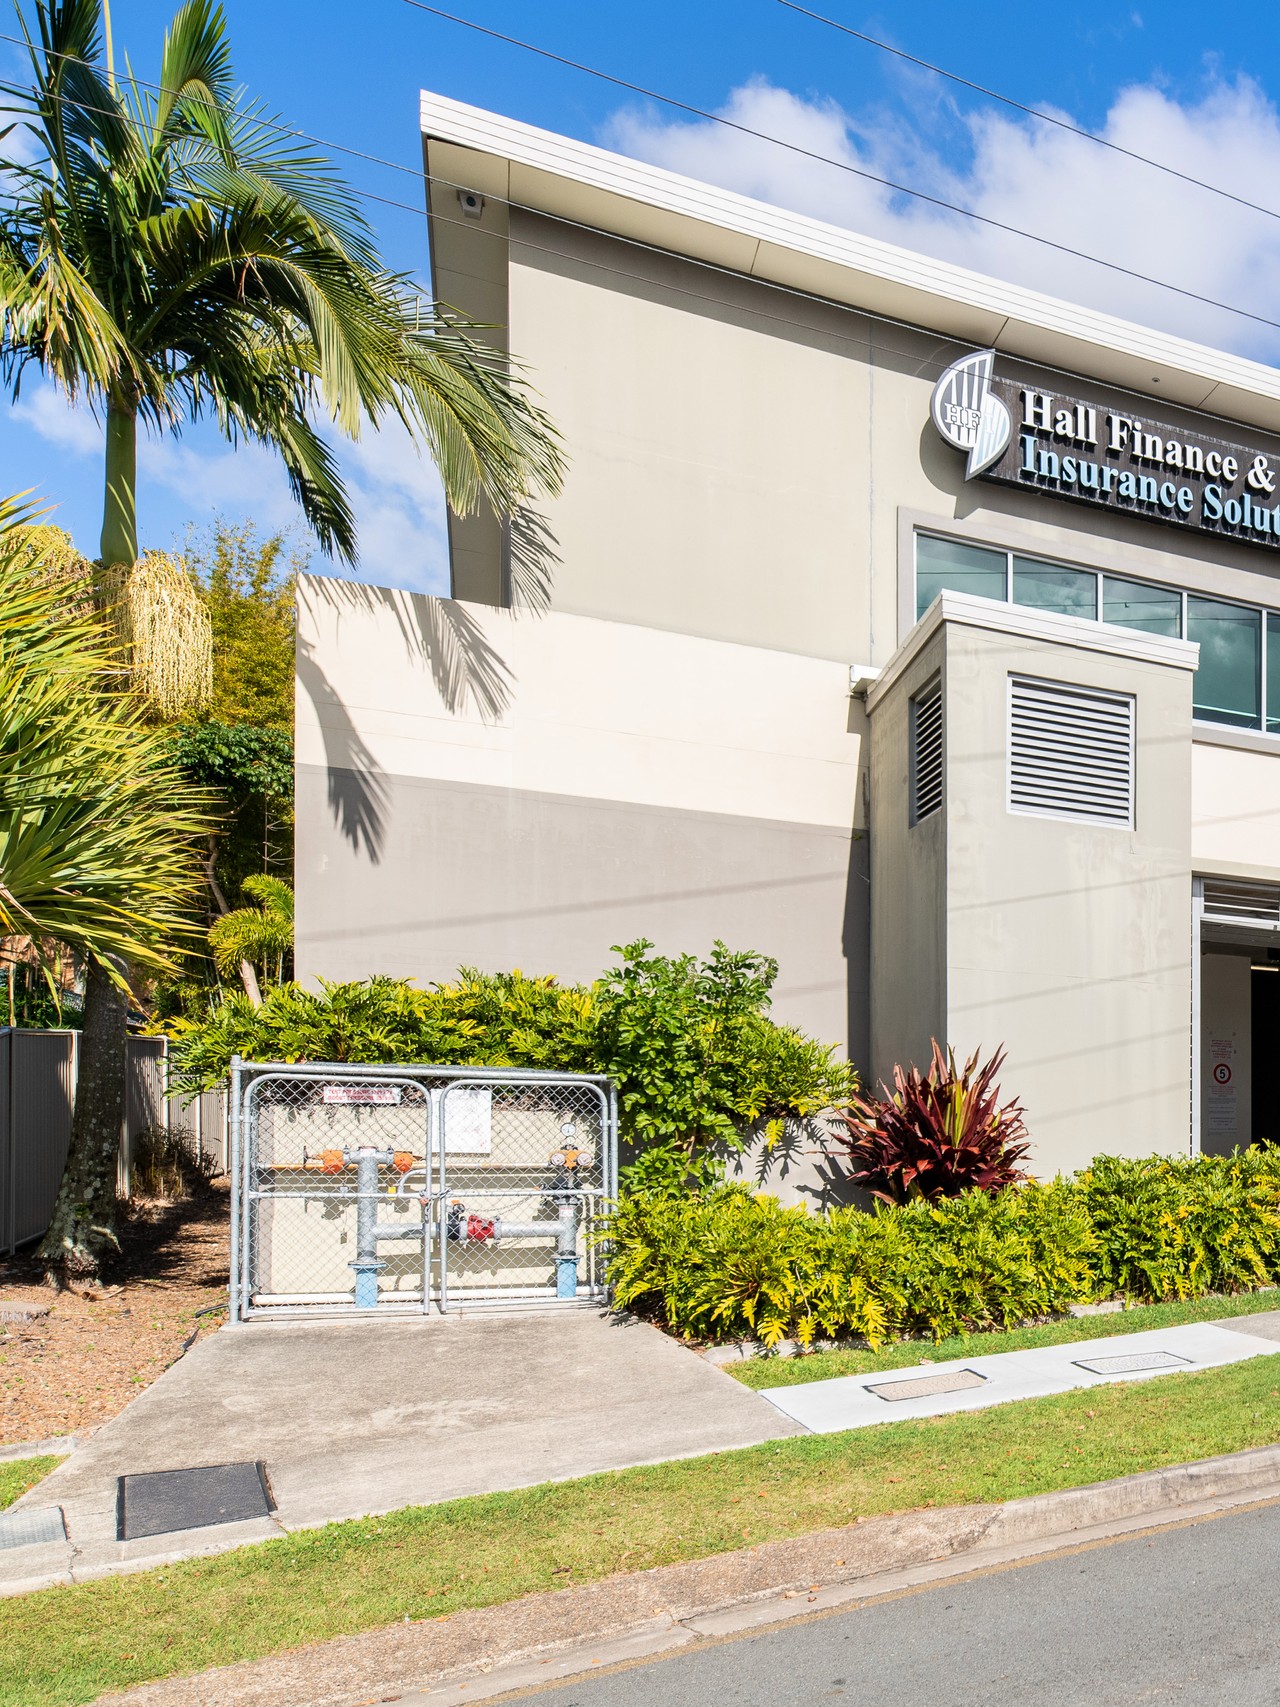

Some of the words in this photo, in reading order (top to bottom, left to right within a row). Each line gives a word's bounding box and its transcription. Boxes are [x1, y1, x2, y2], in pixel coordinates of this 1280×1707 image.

[1021, 435, 1194, 512] Insurance
[1022, 390, 1098, 444] Hall
[1108, 414, 1238, 481] Finance
[1248, 455, 1276, 492] &
[1219, 1068, 1226, 1079] 5
